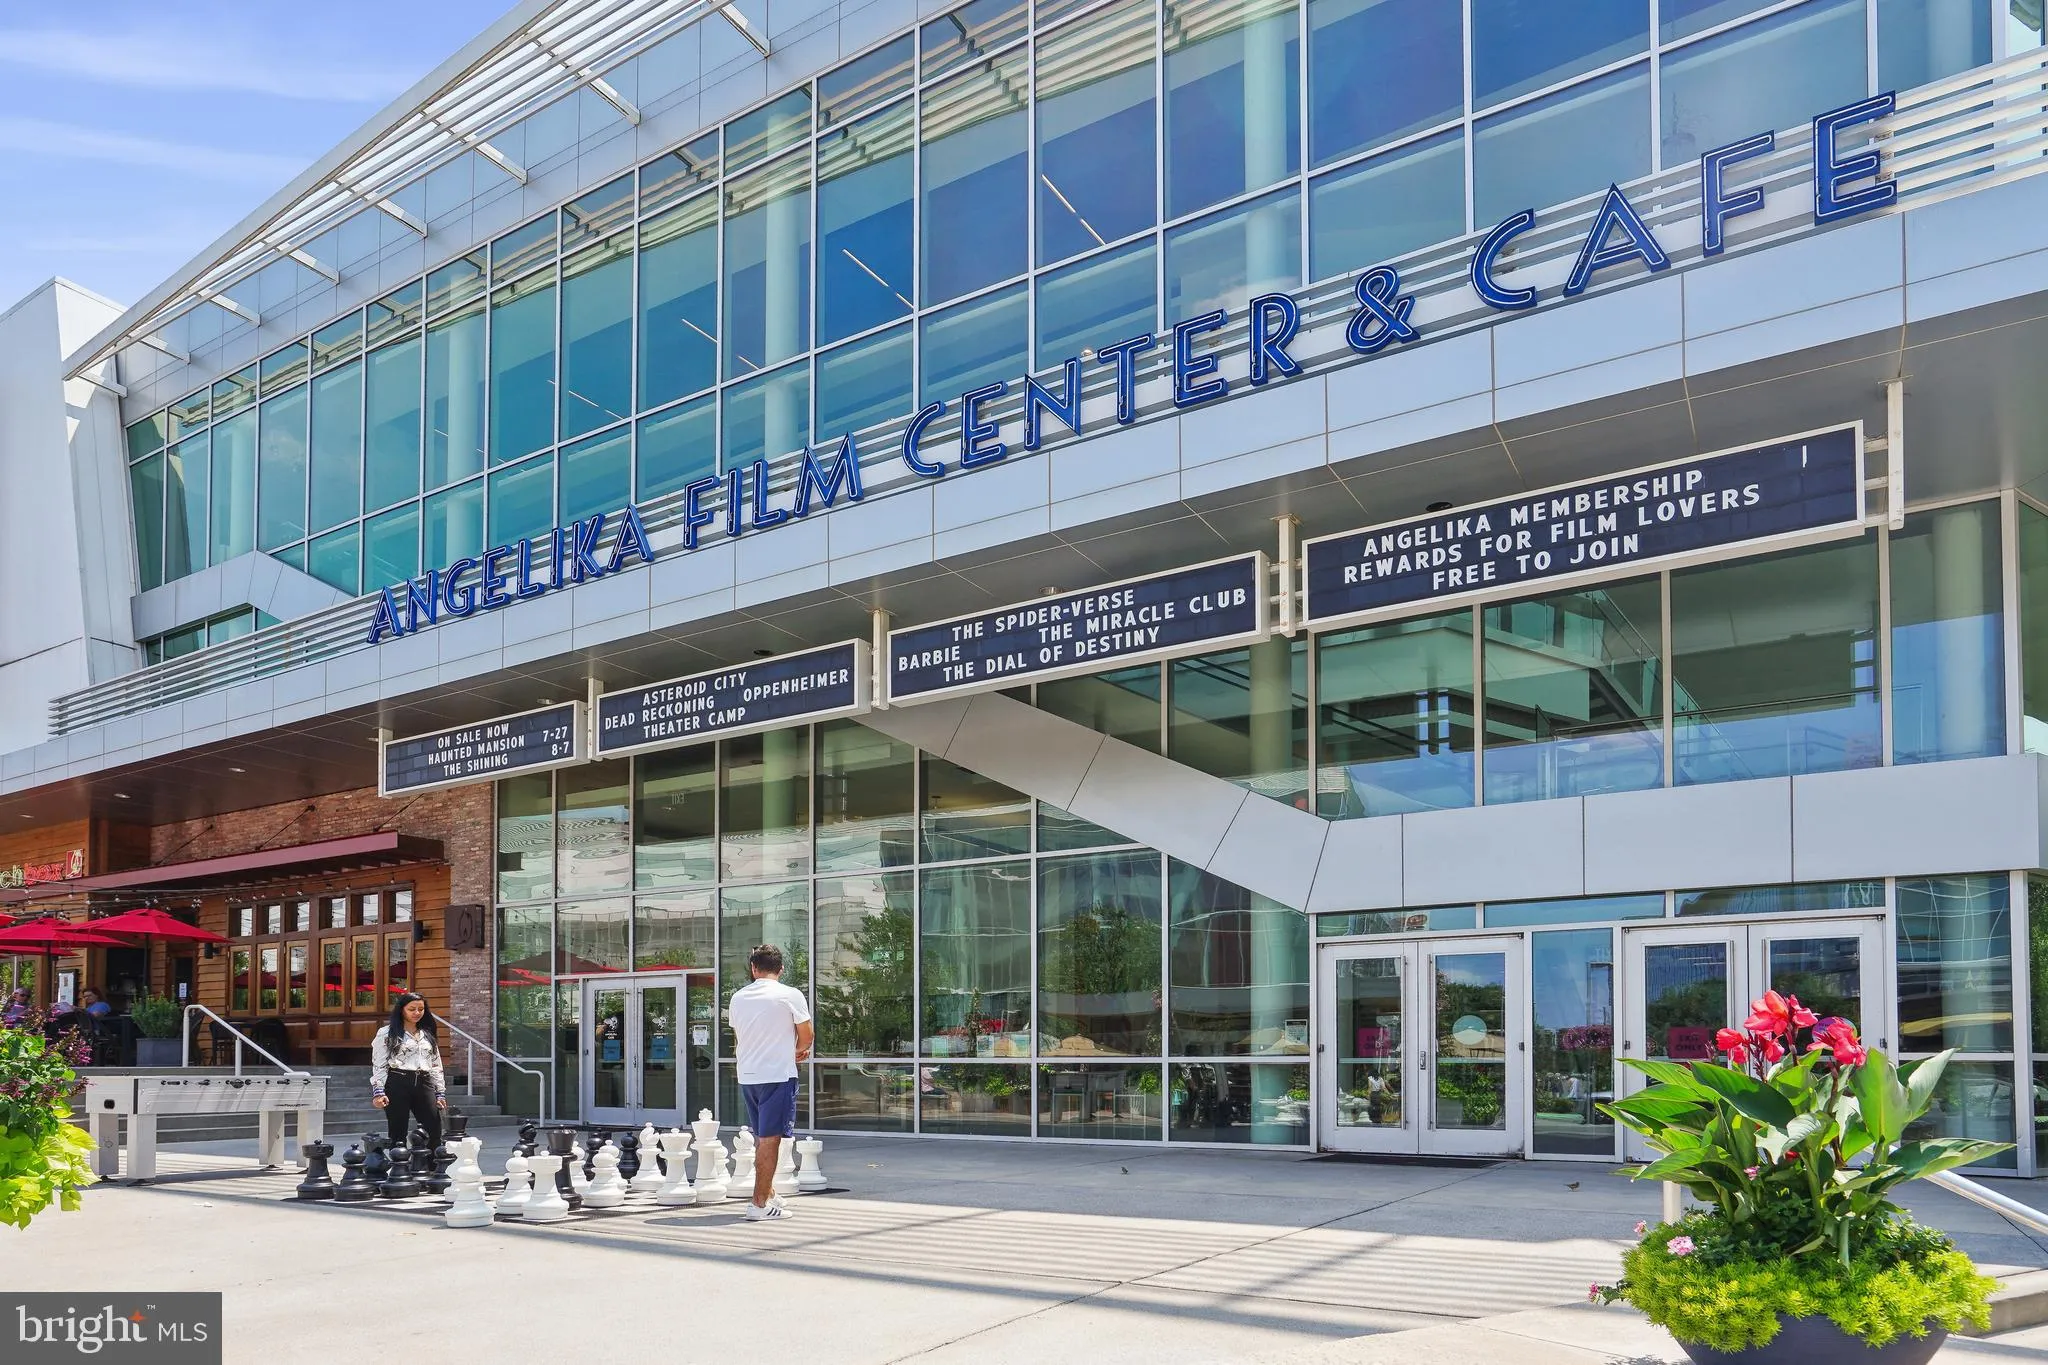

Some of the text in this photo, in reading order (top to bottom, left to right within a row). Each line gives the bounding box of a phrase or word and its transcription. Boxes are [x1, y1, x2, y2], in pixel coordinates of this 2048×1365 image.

[367, 89, 1897, 644] ANGELIKA FILM CENTER & CAFE
[1363, 470, 1704, 558] ANGELIKA MEMBERSHIP
[1344, 483, 1761, 584] REWARDS FOR FILM LOVERS
[1433, 534, 1639, 591] FREE TO JOIN
[952, 589, 1135, 642] THE SPIDER-VERSE
[1039, 588, 1247, 644] THE MIRACLE CLUB
[899, 645, 961, 672] BARBIE
[943, 626, 1161, 683] THE DIAL OF DESTINY
[643, 671, 747, 706] ASTEROID CITY
[743, 668, 849, 702] OPPENHEIMER
[605, 695, 715, 730] DEAD RECKONING
[644, 707, 746, 738] THEATER CAMP
[429, 735, 525, 765] HAUNTED MANSION
[438, 723, 510, 749] ON SALE NOW
[543, 726, 568, 743] 7-27
[551, 741, 569, 756] 8-7
[444, 753, 508, 777] THE SHINING
